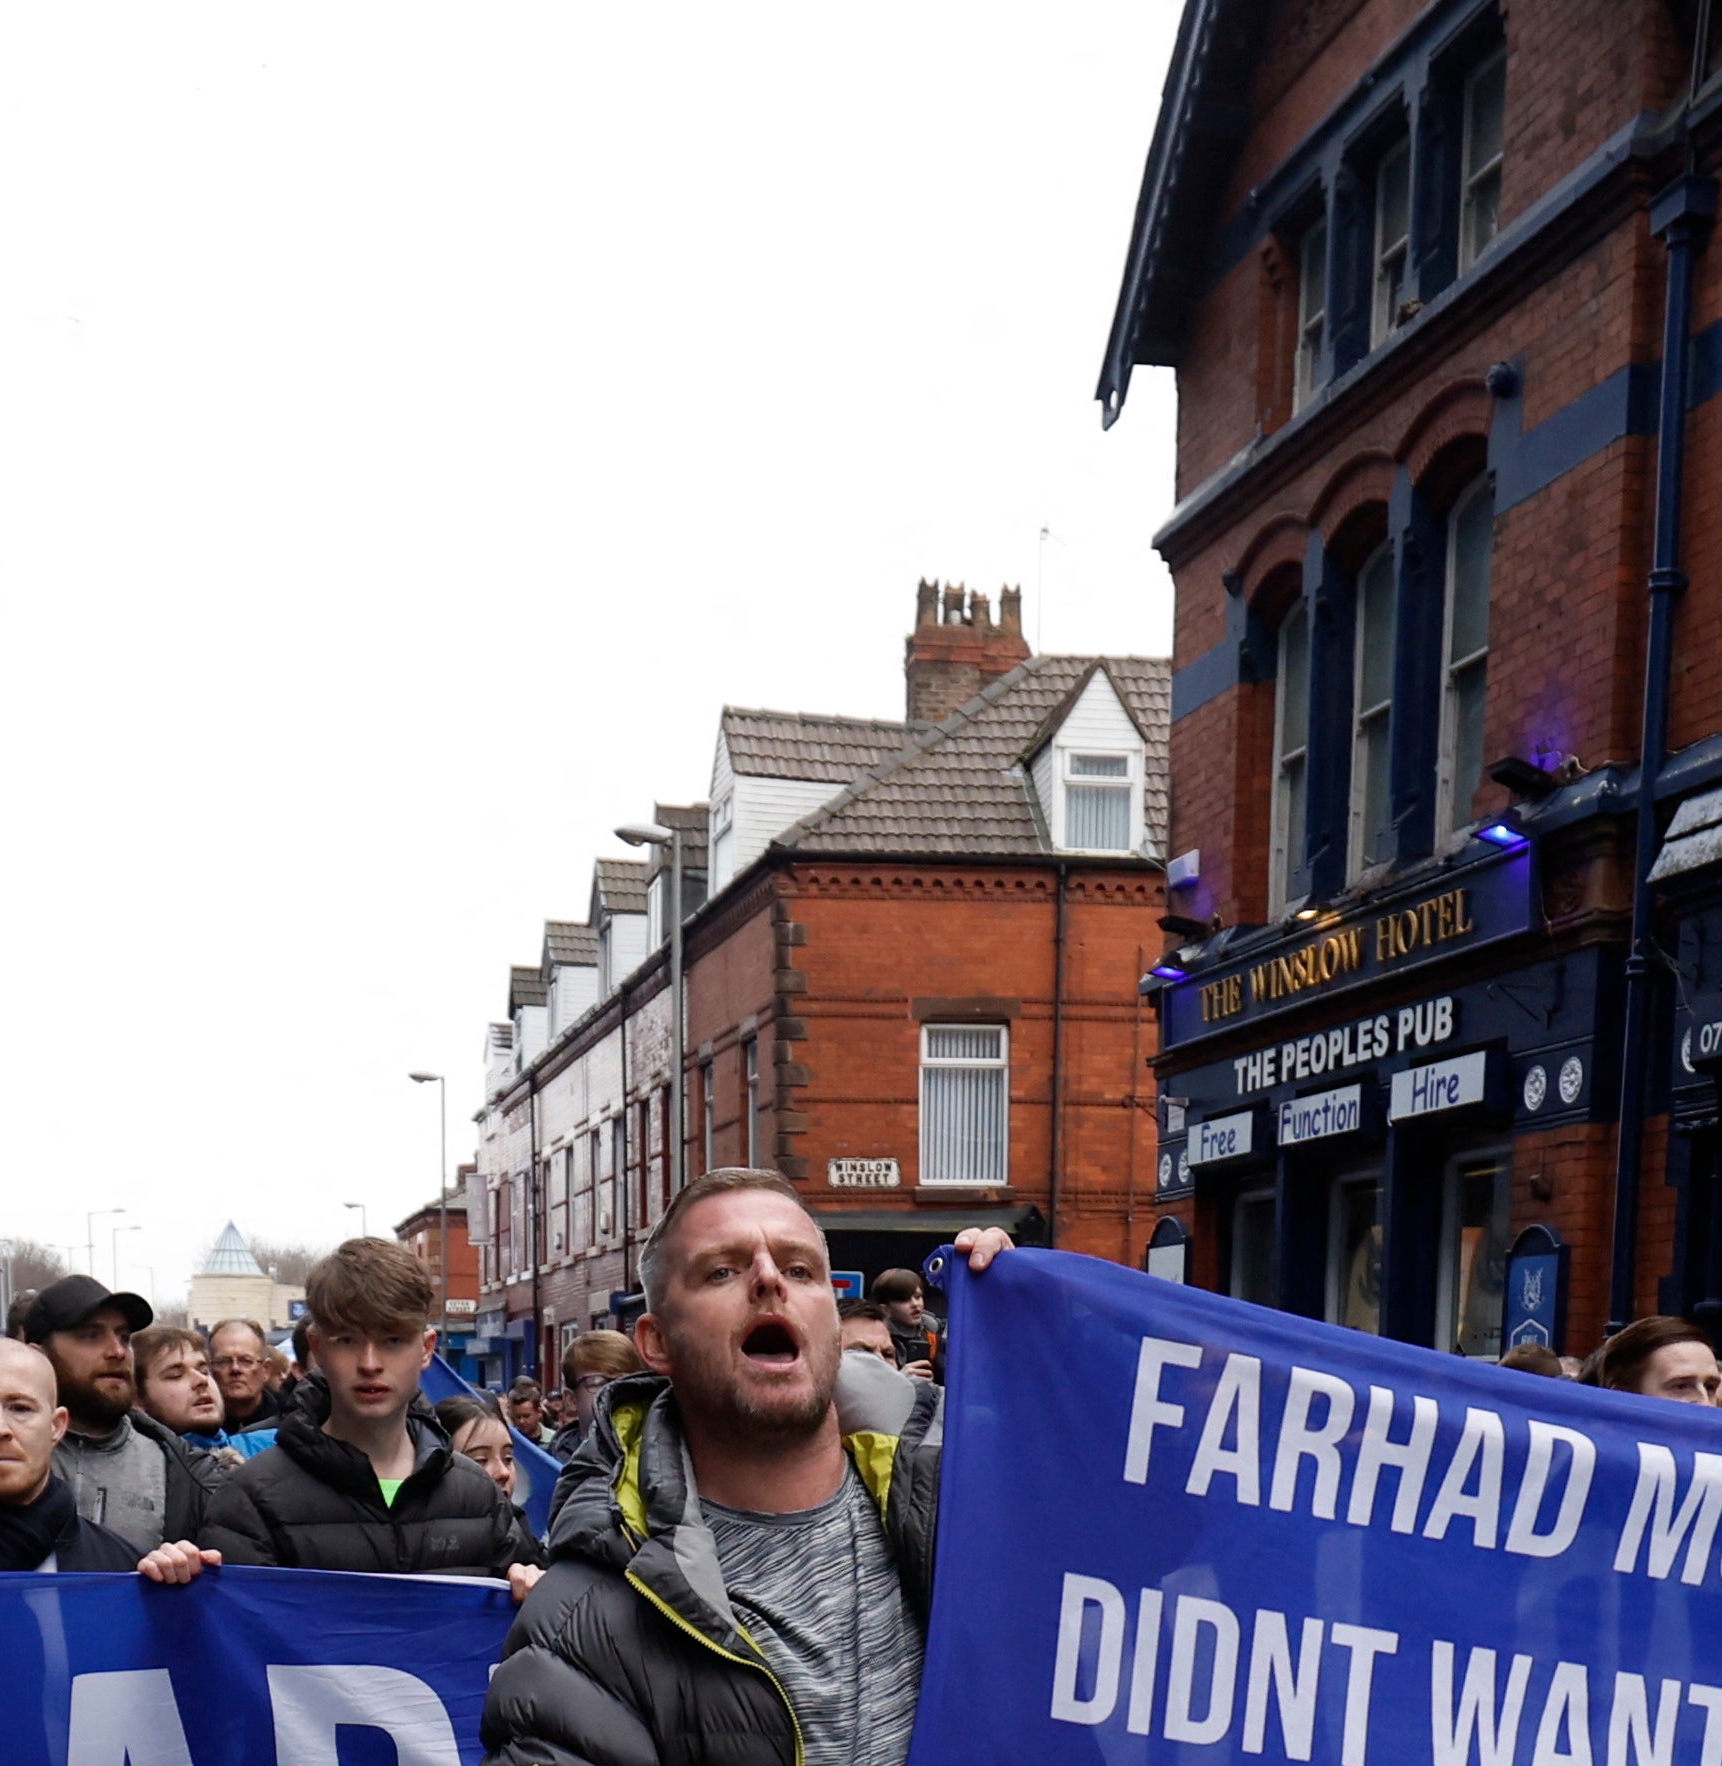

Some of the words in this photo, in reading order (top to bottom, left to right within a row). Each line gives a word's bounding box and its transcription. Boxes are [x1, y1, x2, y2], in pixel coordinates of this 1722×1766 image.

[1198, 974, 1242, 1023] THE
[1250, 927, 1365, 1002] WINSLOW
[1377, 887, 1474, 962] HOTEL
[1234, 1048, 1276, 1094] THE
[1281, 1014, 1390, 1082] PEOPLES
[1397, 996, 1454, 1052] PUB
[1412, 1066, 1460, 1113] Hire
[1200, 1122, 1236, 1161] Free
[1280, 1096, 1358, 1143] Function
[835, 1162, 892, 1173] WINSLOW
[838, 1173, 889, 1184] STREET
[1124, 1337, 1596, 1558] FARHAD
